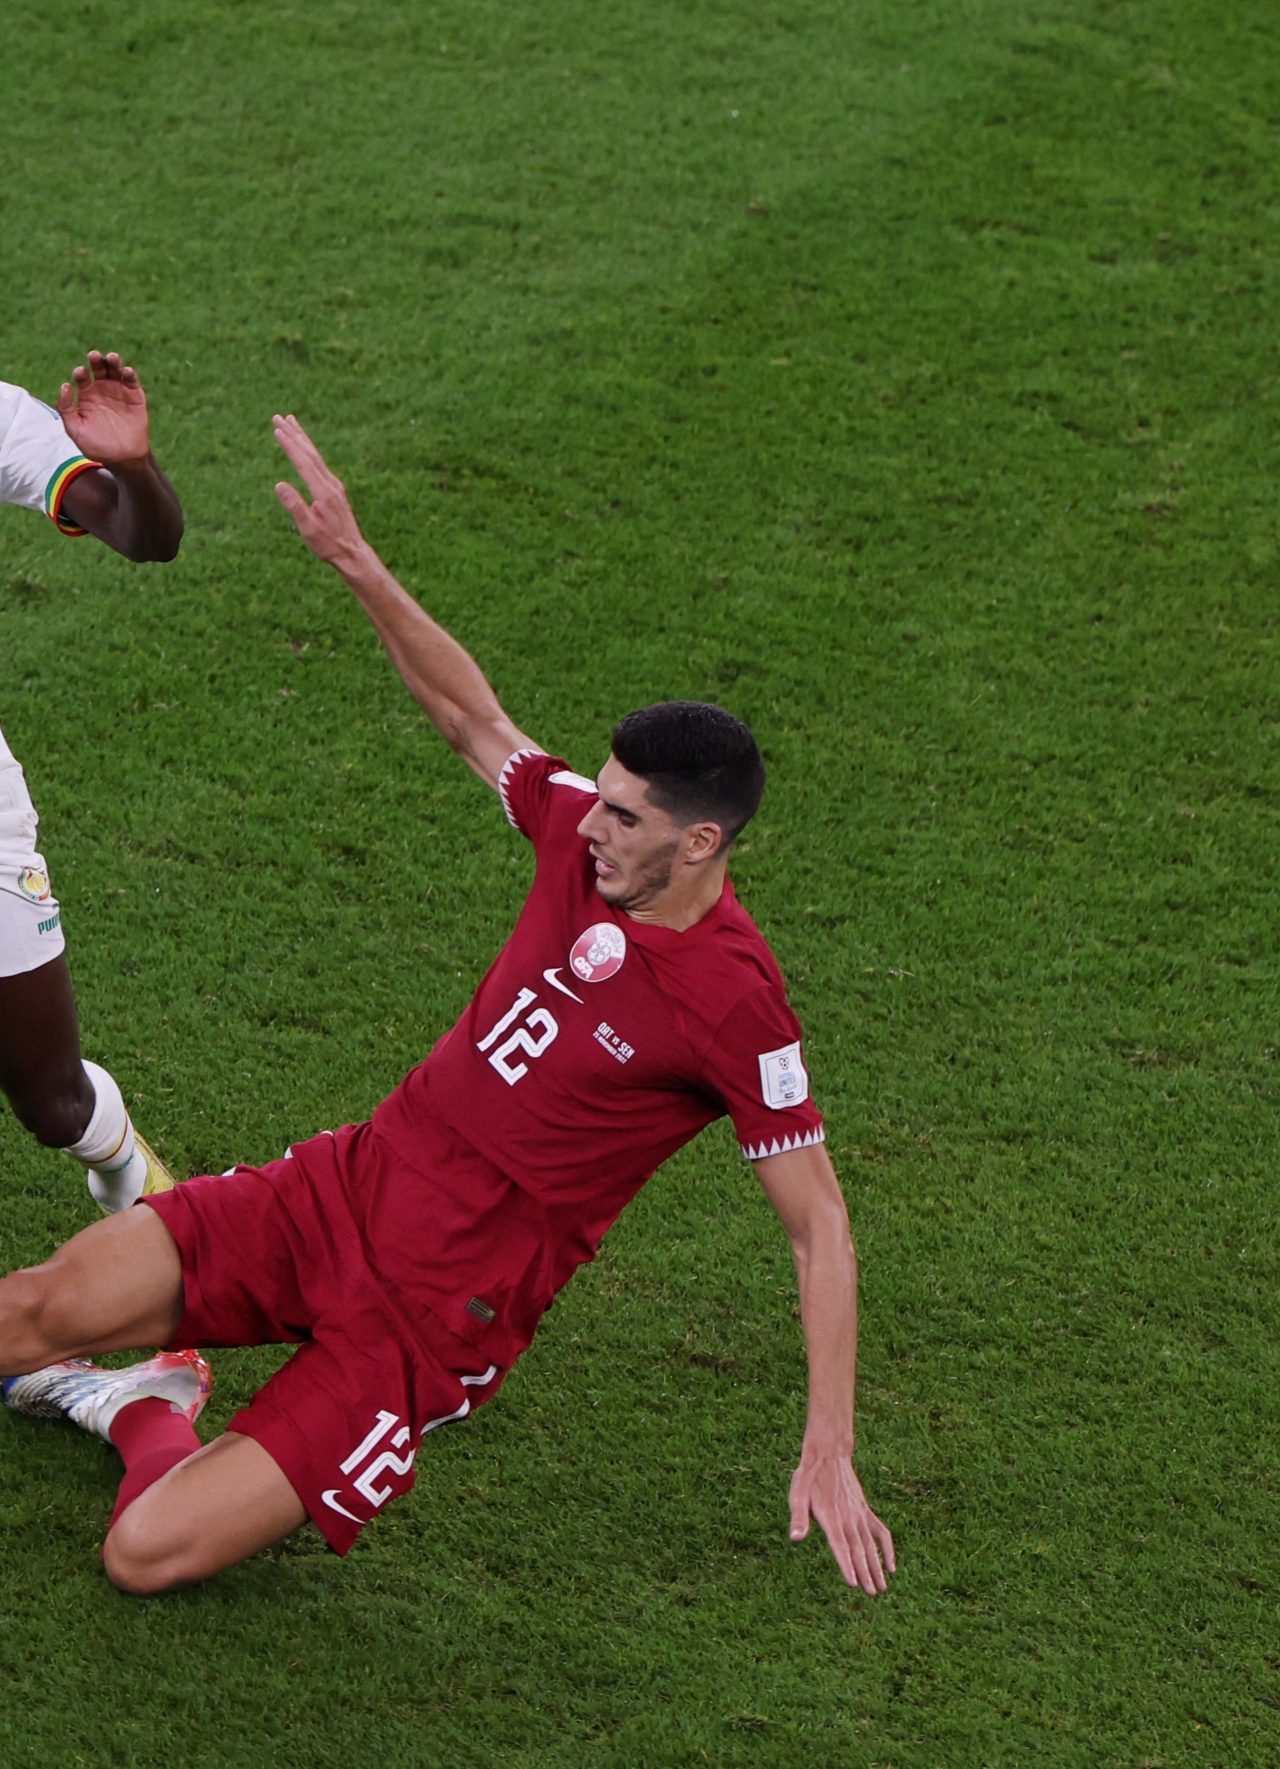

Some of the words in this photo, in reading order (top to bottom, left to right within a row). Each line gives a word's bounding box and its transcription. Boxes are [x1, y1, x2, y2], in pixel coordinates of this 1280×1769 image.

[37, 914, 60, 936] PUM
[574, 956, 594, 979] QFA
[476, 987, 559, 1087] 12
[597, 1021, 615, 1040] QAT
[617, 1042, 636, 1060] SEN
[338, 1409, 416, 1508] 12
